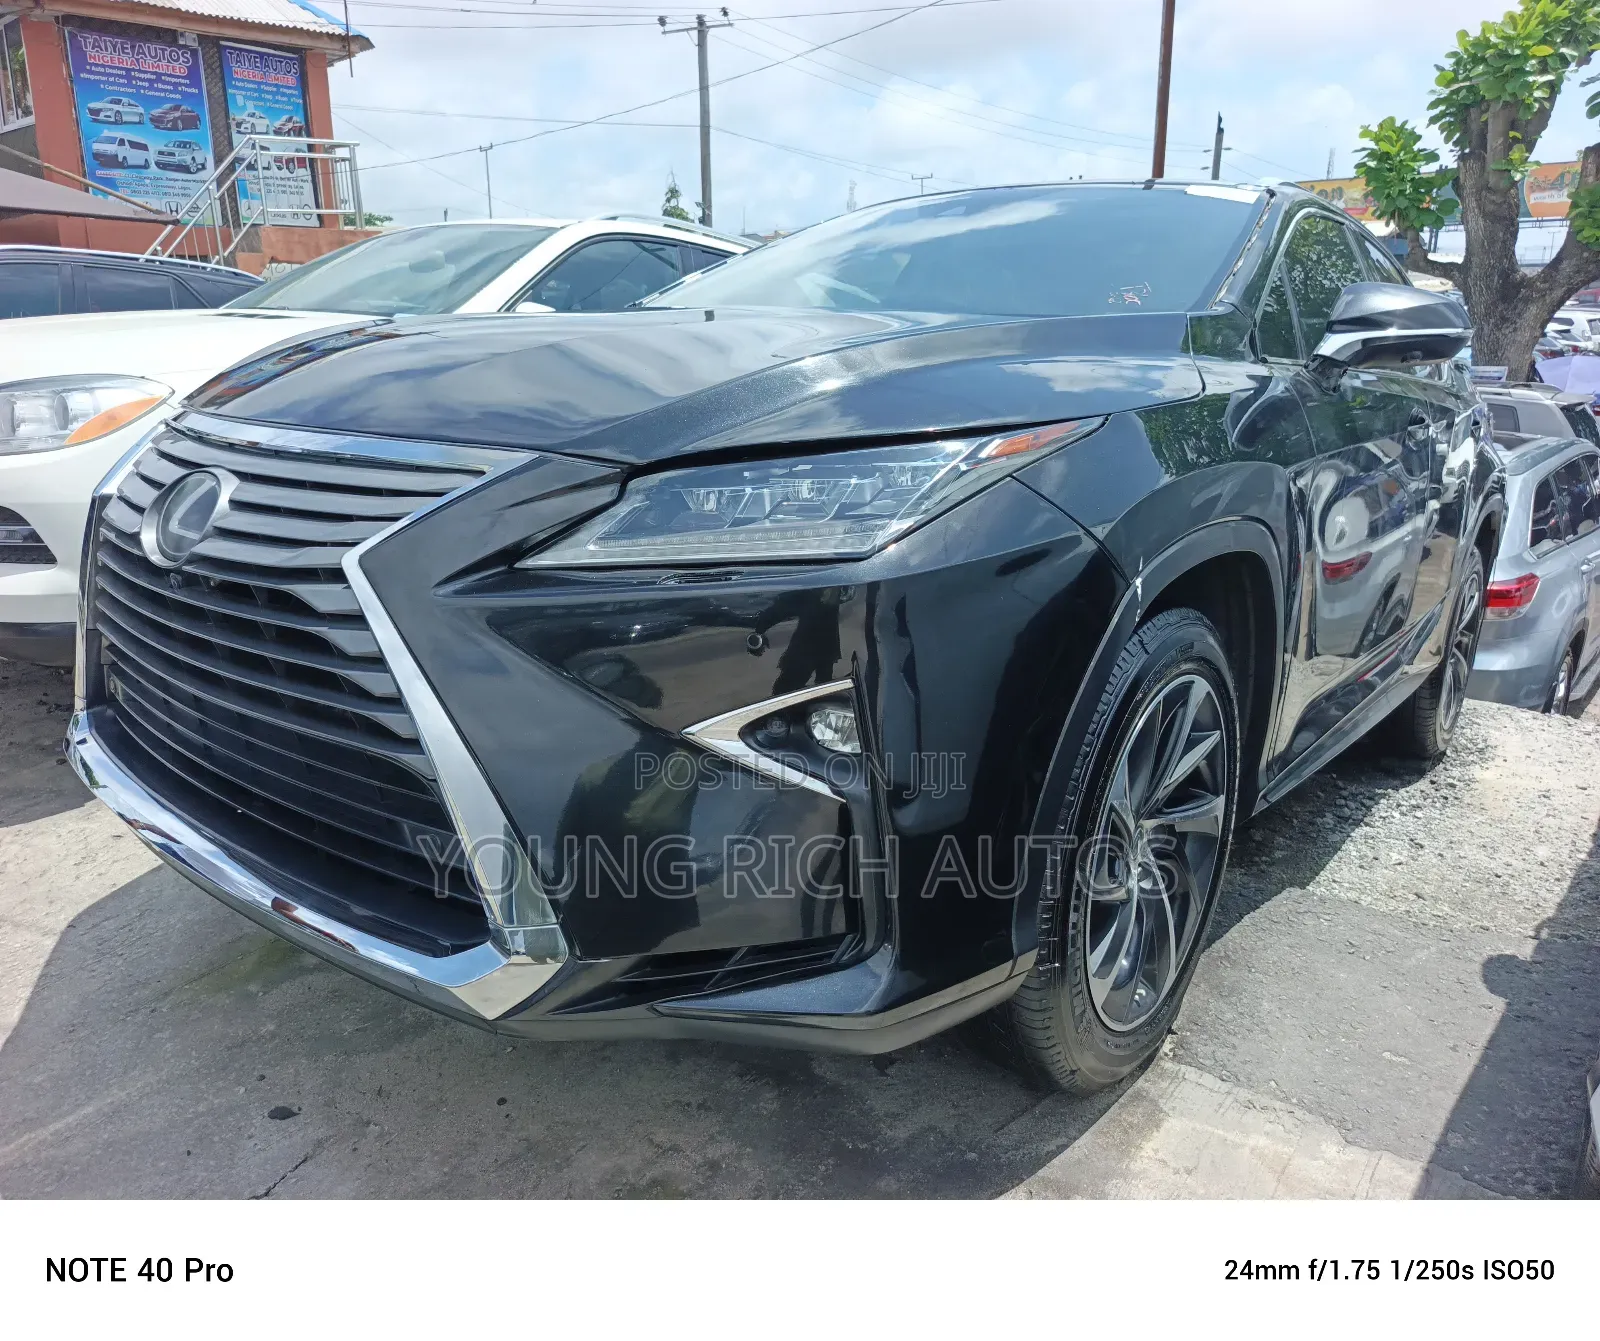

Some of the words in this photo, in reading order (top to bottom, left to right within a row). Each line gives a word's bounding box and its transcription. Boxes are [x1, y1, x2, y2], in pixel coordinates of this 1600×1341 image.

[78, 34, 132, 57] TAIYE
[135, 43, 192, 66] AUTOS
[87, 52, 139, 69] NIGERIA
[140, 60, 188, 76] LIMITED
[226, 50, 260, 70] TAIYE
[262, 56, 299, 76] AUTOS
[233, 67, 265, 81] NIGERIA
[265, 73, 297, 87] LIMITED
